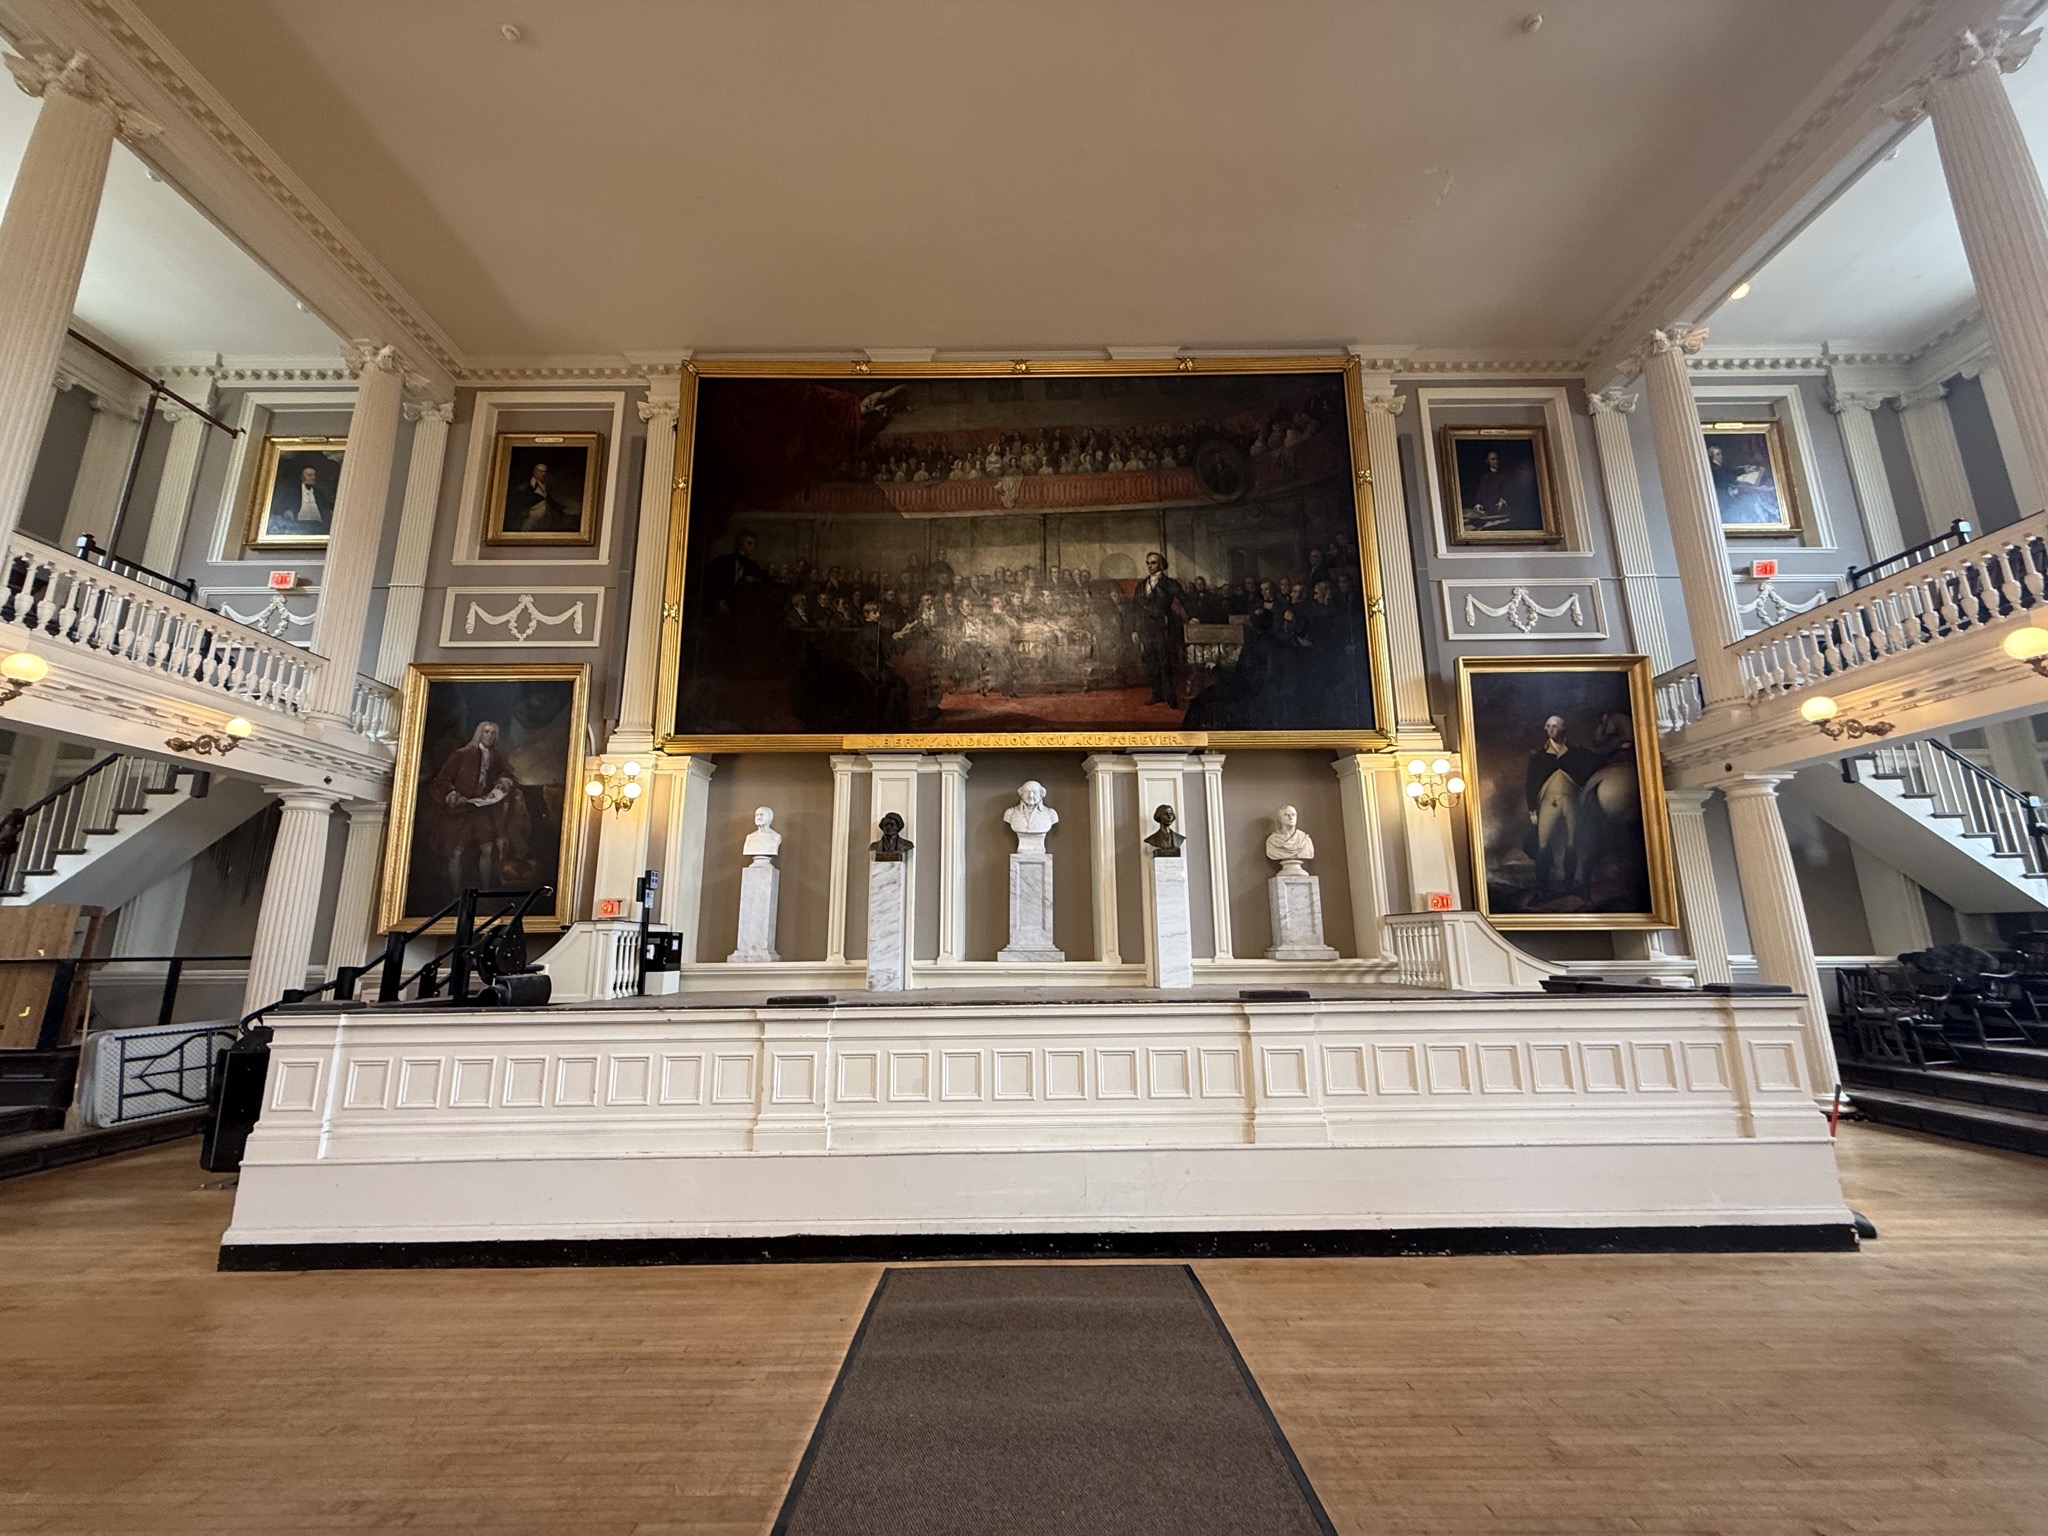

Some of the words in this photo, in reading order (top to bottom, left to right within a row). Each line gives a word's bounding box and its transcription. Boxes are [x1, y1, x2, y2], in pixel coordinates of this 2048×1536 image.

[942, 735, 976, 747] AND
[982, 735, 1030, 747] UNION
[1037, 735, 1067, 746] NOW
[1072, 735, 1104, 746] AND
